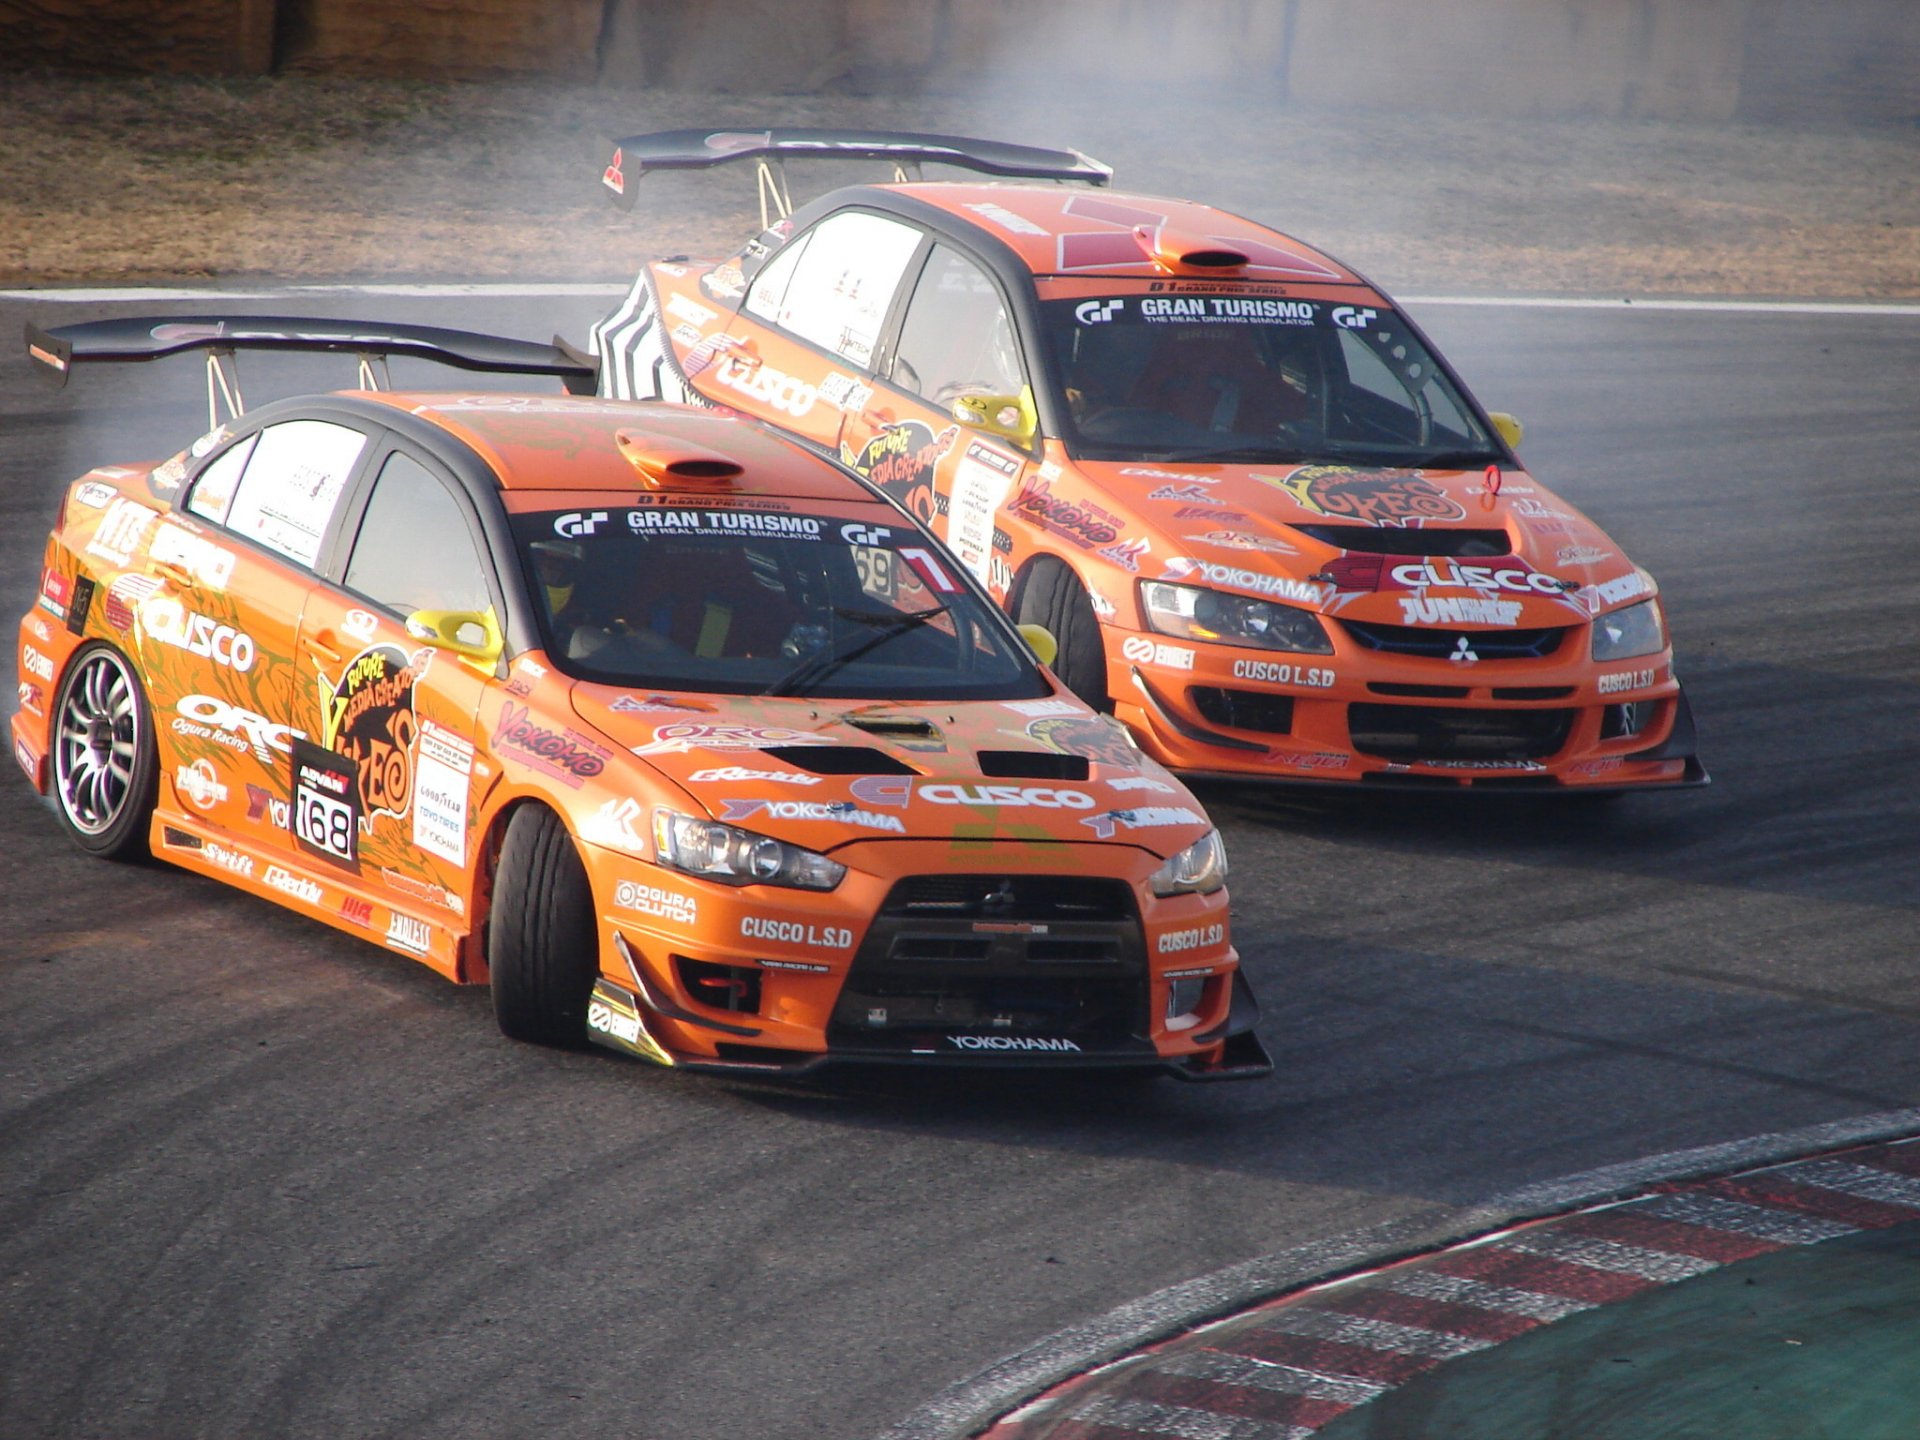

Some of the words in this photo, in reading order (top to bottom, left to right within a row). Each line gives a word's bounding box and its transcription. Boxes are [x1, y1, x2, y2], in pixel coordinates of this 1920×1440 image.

[1141, 299, 1206, 316] GRAN
[1210, 299, 1314, 319] TURISMO
[1201, 316, 1248, 324] DRIVING
[1249, 317, 1316, 327] SIMULATOR
[627, 511, 700, 529] GRAN
[705, 512, 820, 535] TURISMO
[1007, 475, 1117, 543] YOKOMO
[631, 528, 658, 536] THE
[659, 528, 694, 536] REAL
[694, 528, 748, 537] DRIVING
[748, 529, 822, 541] SIMULATOR
[1201, 561, 1323, 605] YOKOHAMA
[1390, 564, 1562, 595] CUSCO
[143, 599, 255, 673] CUSCO
[347, 652, 386, 695] FUTURE
[1233, 659, 1292, 684] CUSCO
[1598, 674, 1632, 694] CUSCO
[171, 718, 212, 739] Ogura
[211, 728, 249, 753] Racing
[176, 694, 307, 753] ORC
[490, 700, 605, 777] YOKOMO
[300, 765, 345, 794] ADVAN
[917, 784, 1097, 810] CUSCO
[299, 793, 350, 856] 168
[764, 801, 907, 834] YOKOHAMA
[208, 842, 253, 875] Swift
[635, 901, 696, 925] CLUTCH
[636, 885, 697, 912] OGURA
[741, 916, 804, 944] CUSCO
[807, 926, 853, 949] L.S.D
[1158, 929, 1199, 954] CUSCO
[947, 1035, 1082, 1053] YOKOHAMA
